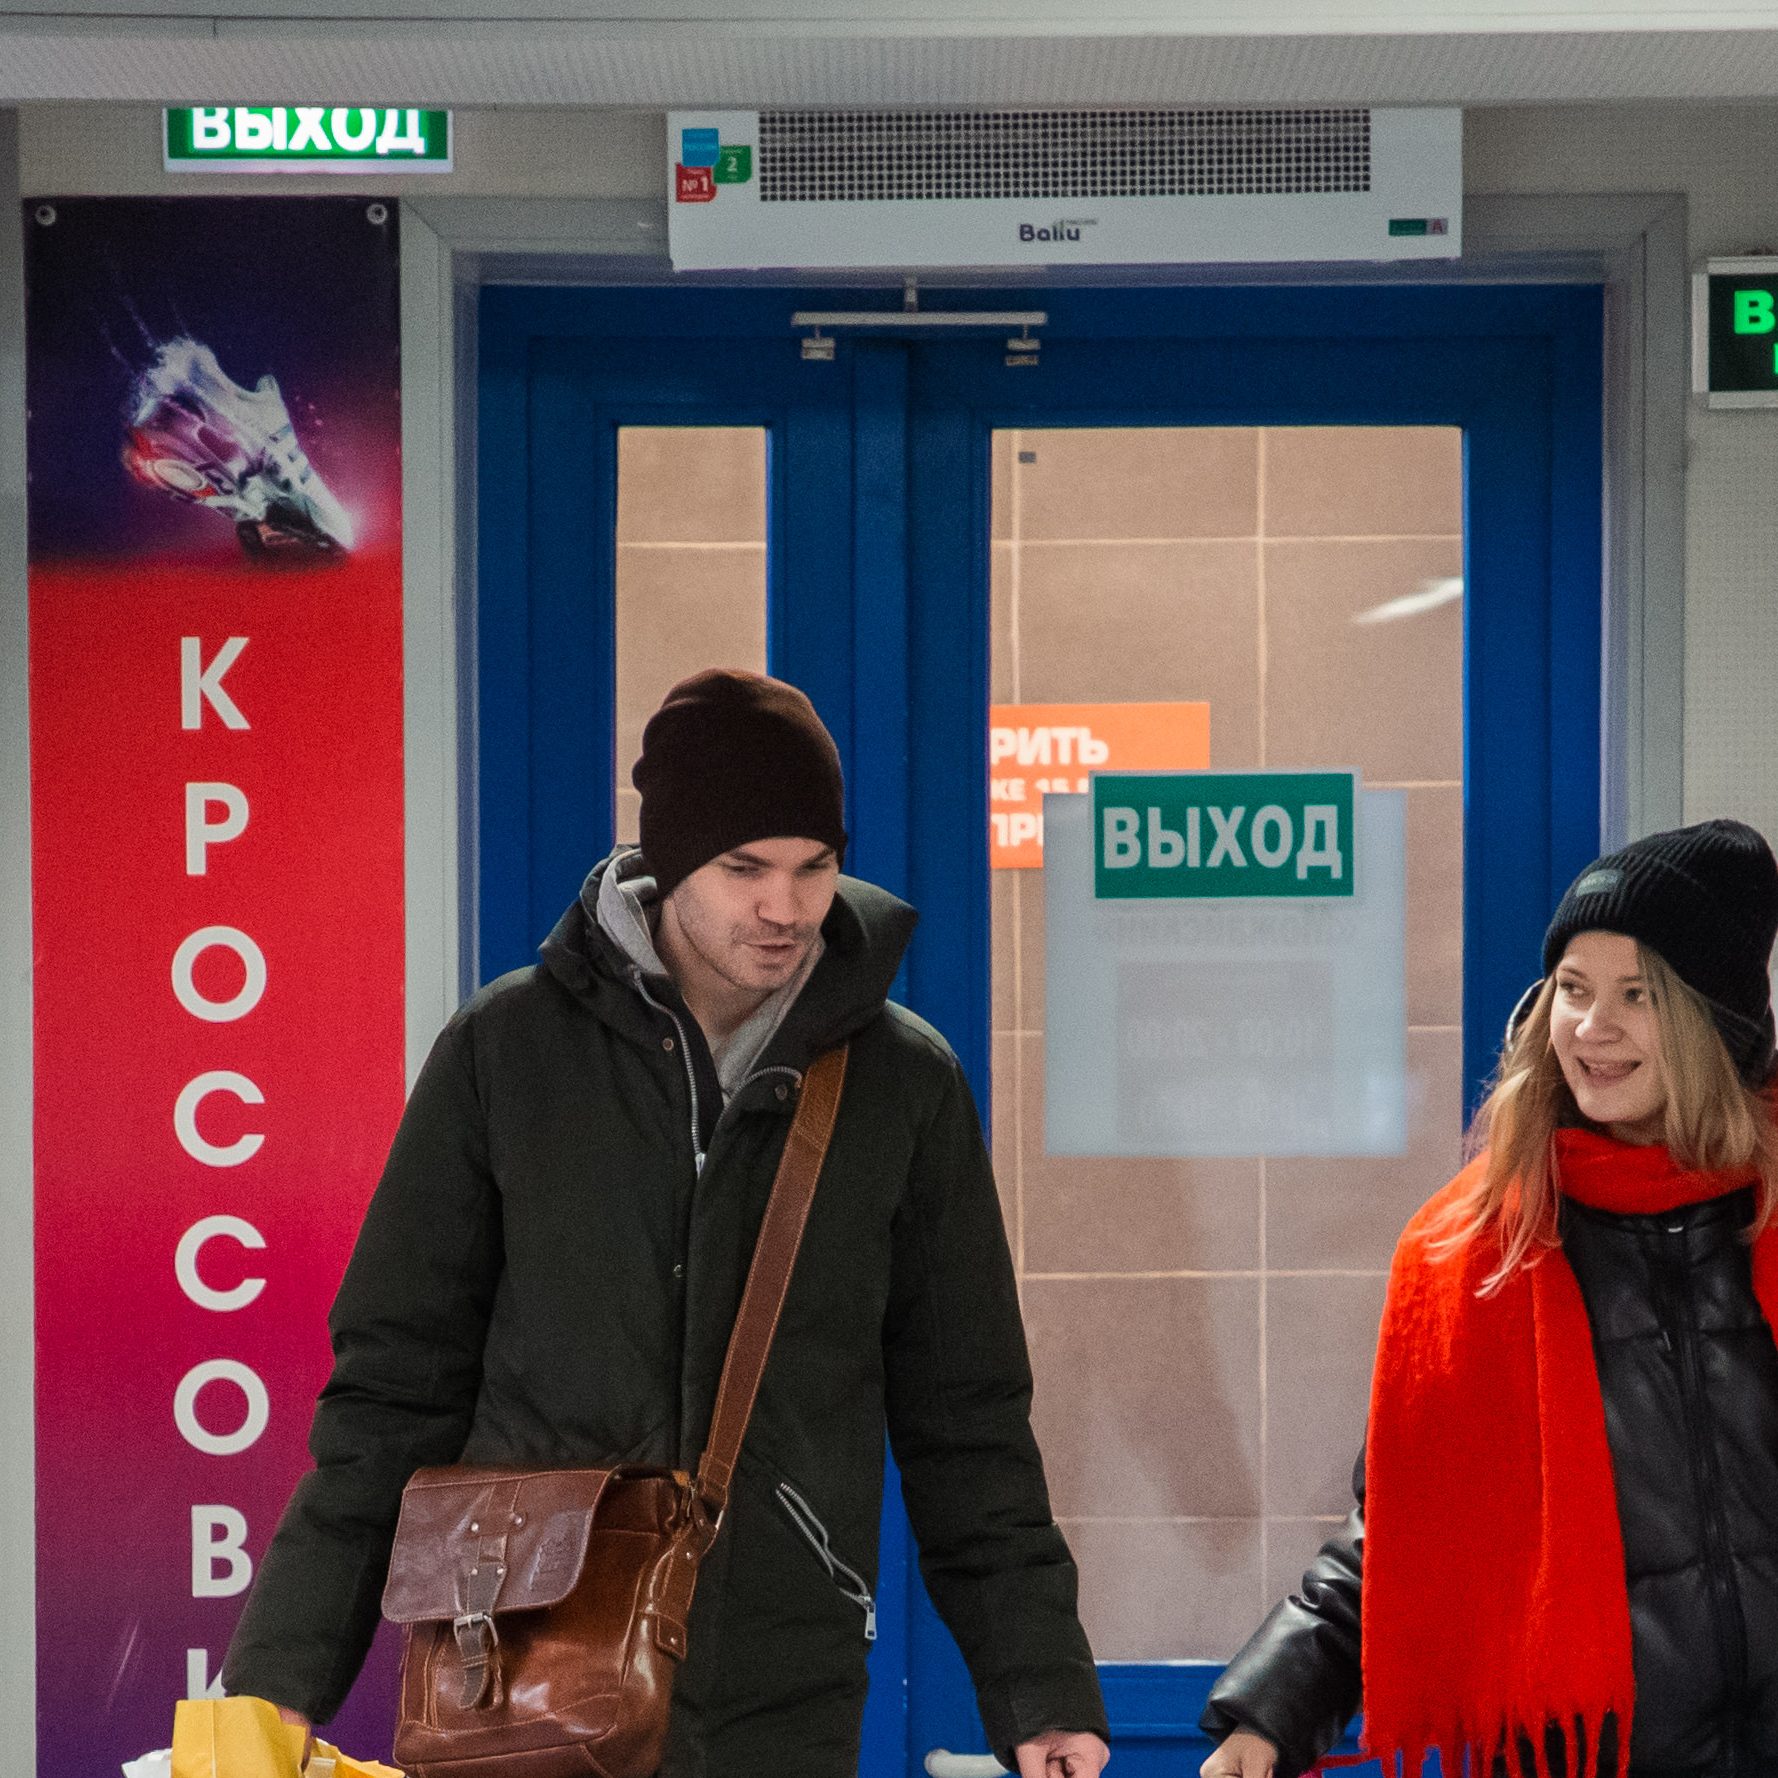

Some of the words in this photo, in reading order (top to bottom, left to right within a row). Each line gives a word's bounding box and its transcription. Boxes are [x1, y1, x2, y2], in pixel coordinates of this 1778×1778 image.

[192, 107, 425, 155] ВЫХОД
[1018, 219, 1081, 242] Ballu
[1102, 803, 1343, 880] ВЫХОД
